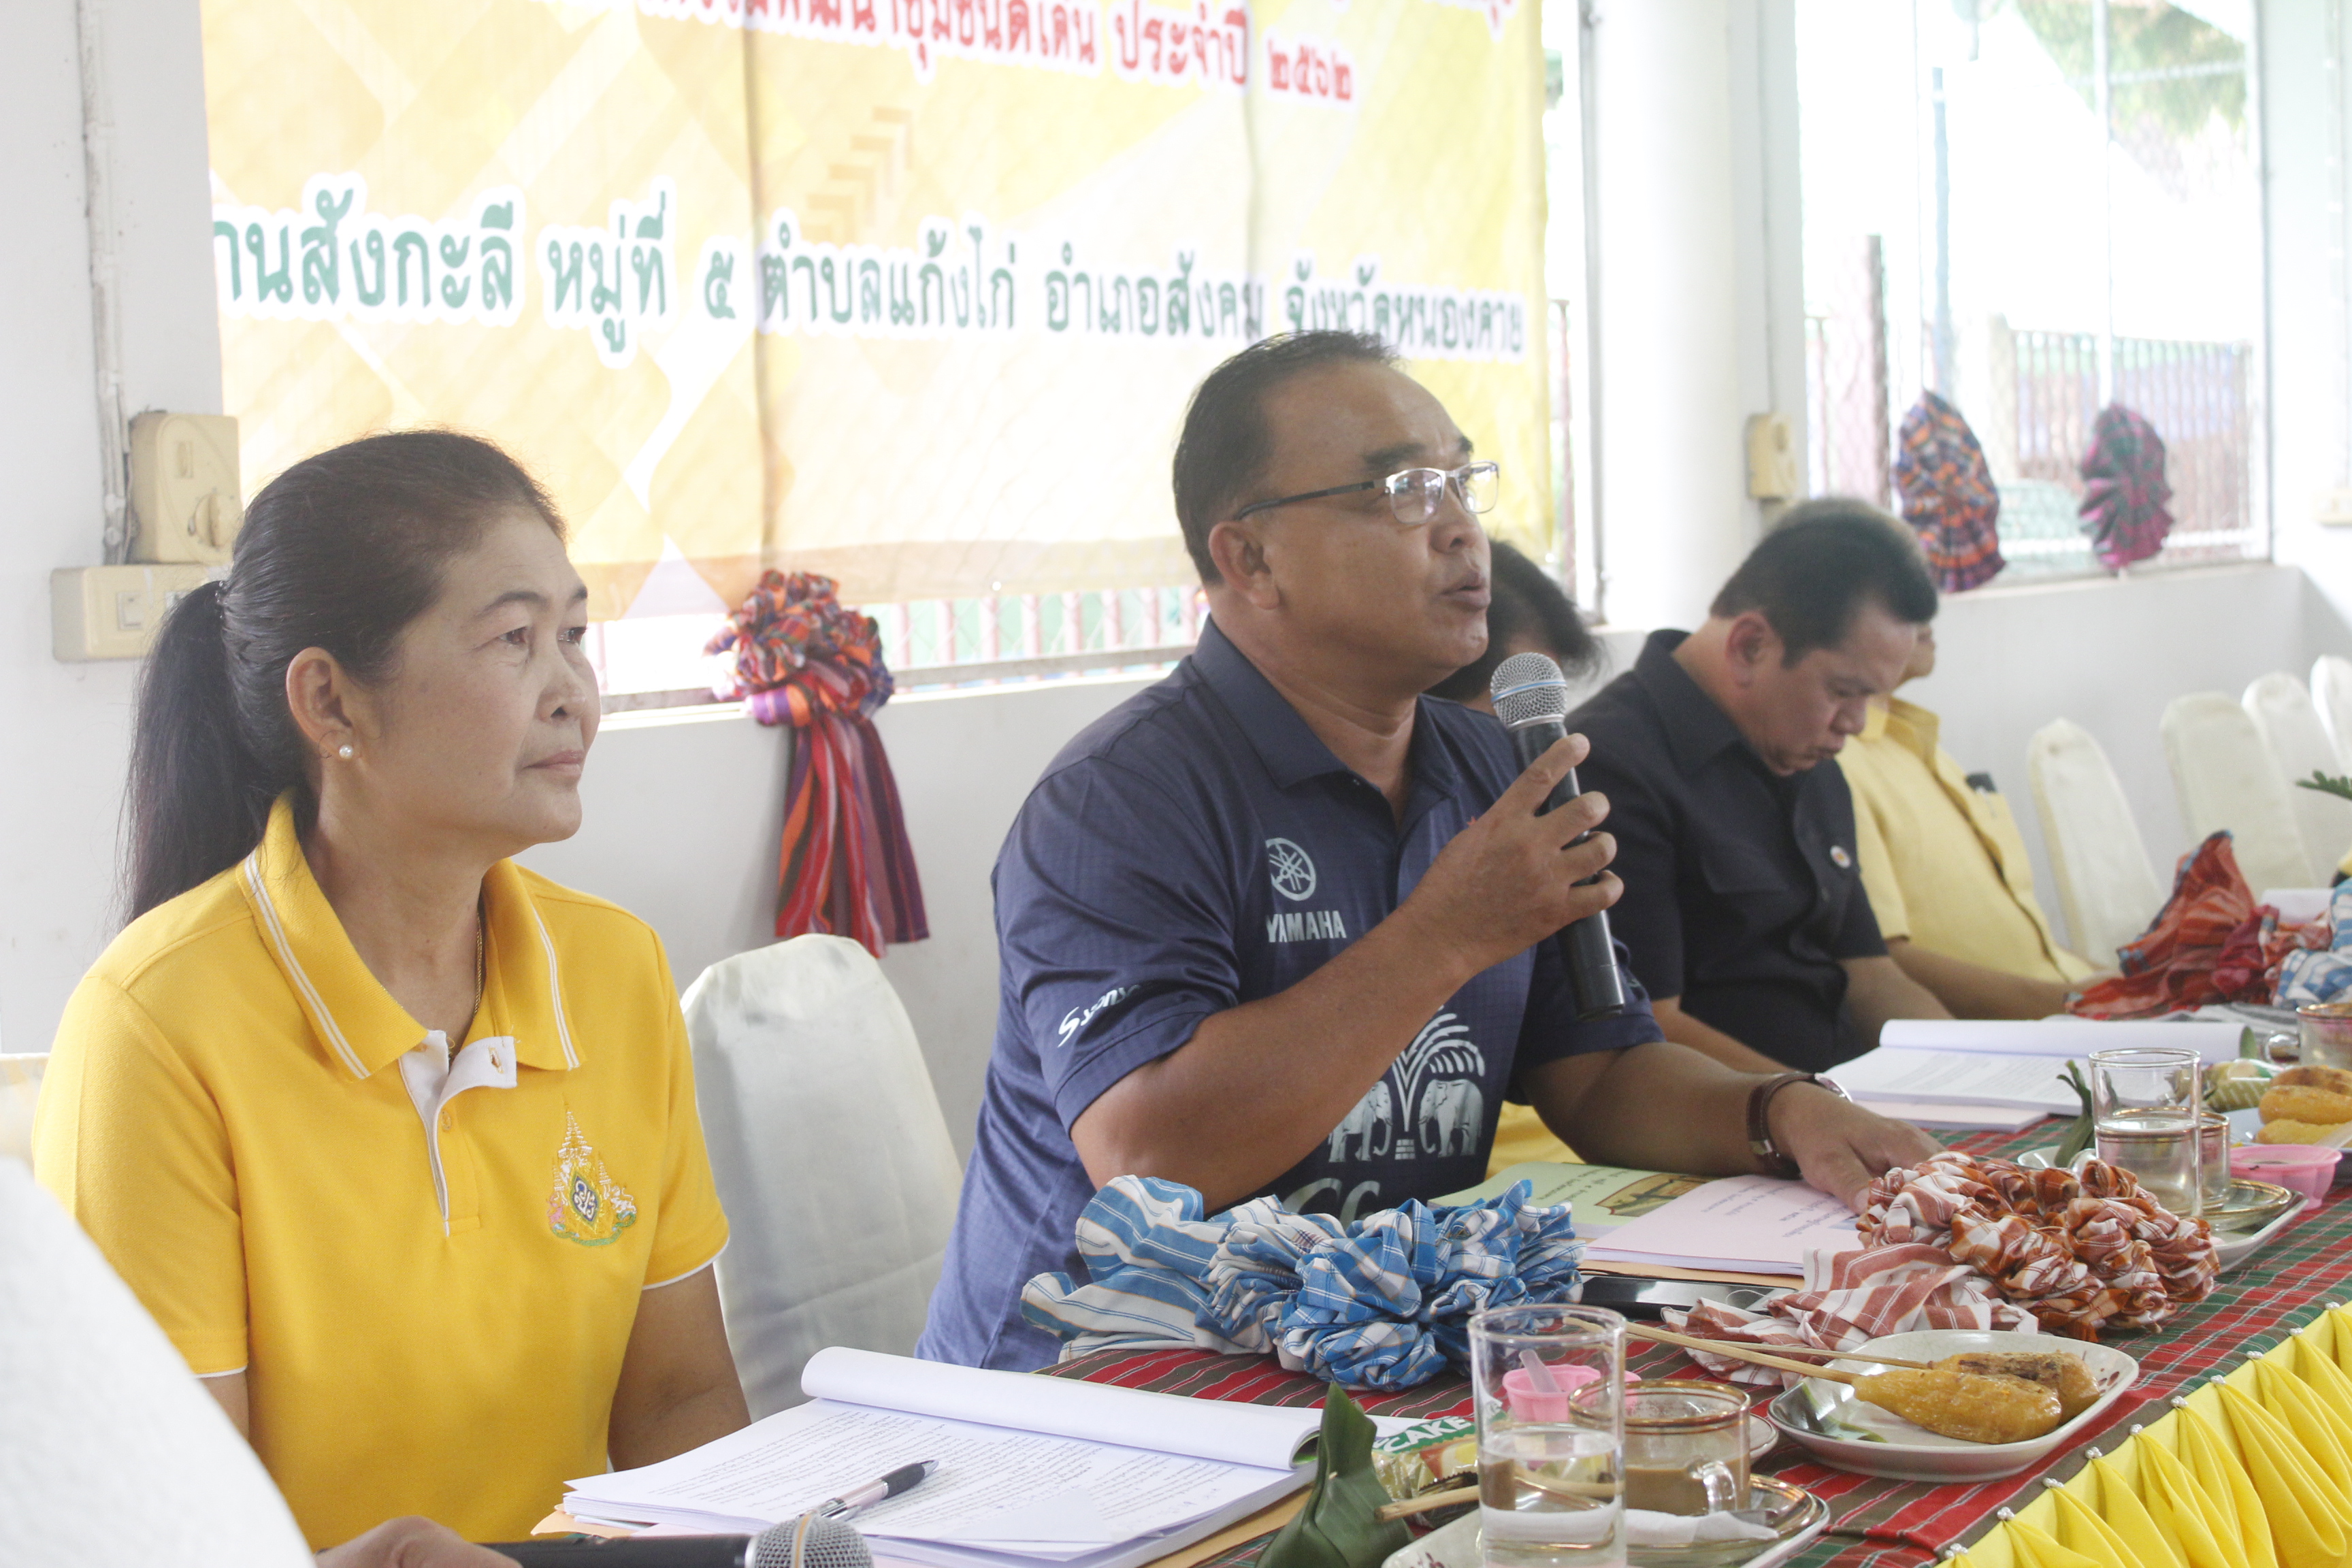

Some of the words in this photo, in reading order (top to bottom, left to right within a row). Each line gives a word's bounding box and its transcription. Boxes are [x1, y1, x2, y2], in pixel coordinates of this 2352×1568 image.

[1115, 0, 1247, 85] ประจำปี
[547, 190, 666, 353] หมู่ที่
[704, 250, 736, 319] ๕
[760, 221, 1015, 331] ตำบลแก้งไก่
[1045, 242, 1264, 340] อำเภอสังคม
[1266, 910, 1348, 943] YAMAHA
